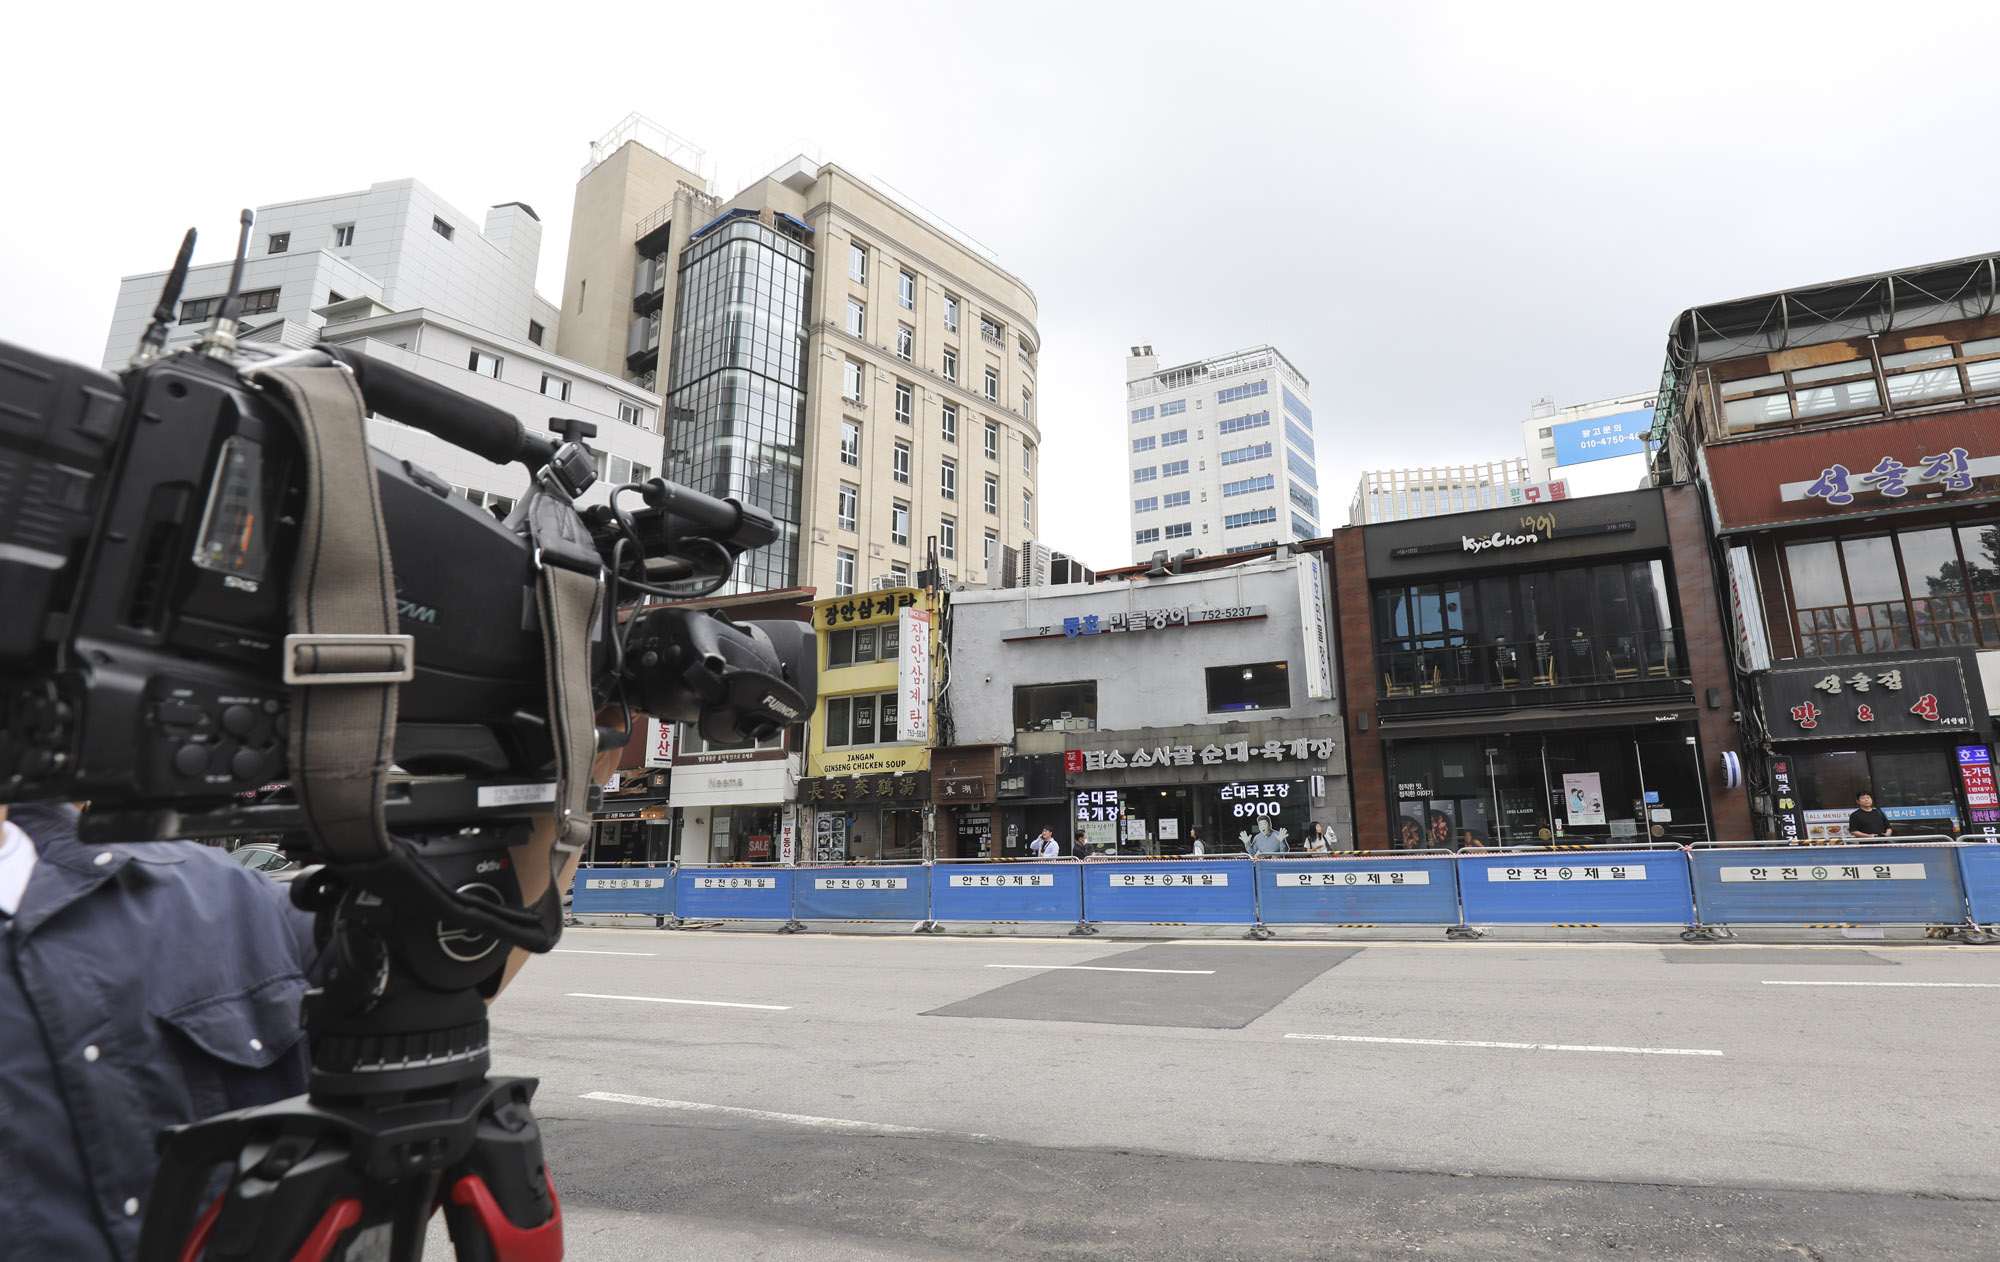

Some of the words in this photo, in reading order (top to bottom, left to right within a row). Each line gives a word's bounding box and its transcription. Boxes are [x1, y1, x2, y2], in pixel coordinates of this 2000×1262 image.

[1581, 432, 1640, 449] 010-4750-46
[1805, 447, 1974, 505] 선술집
[1524, 481, 1566, 504] 모텔
[1063, 614, 1102, 638] 동호
[1109, 606, 1189, 633] 민물장어
[1201, 606, 1252, 621] 752-5237
[1039, 627, 1050, 636] 2F
[909, 622, 924, 729] 장안삼계탕
[1814, 670, 1903, 694] 선술집
[762, 694, 799, 719] FUJINON
[1857, 703, 1875, 722] &
[1909, 693, 1940, 722] 선
[656, 723, 671, 757] 동산
[907, 729, 926, 738] 753-5834
[847, 753, 874, 762] JANGAN
[1960, 749, 1990, 762] 호프
[824, 763, 851, 773] GINSENG
[852, 761, 884, 771] CHICKEN
[885, 760, 906, 769] SOUP
[1962, 766, 1992, 777] 노가리
[1077, 790, 1118, 806] 순대국
[1220, 785, 1260, 801] 순대국
[1262, 783, 1291, 799] 포장
[1077, 806, 1119, 822] 육개장
[1233, 801, 1281, 818] 8900
[1885, 809, 1916, 818] 영업시간
[749, 841, 769, 851] SALE
